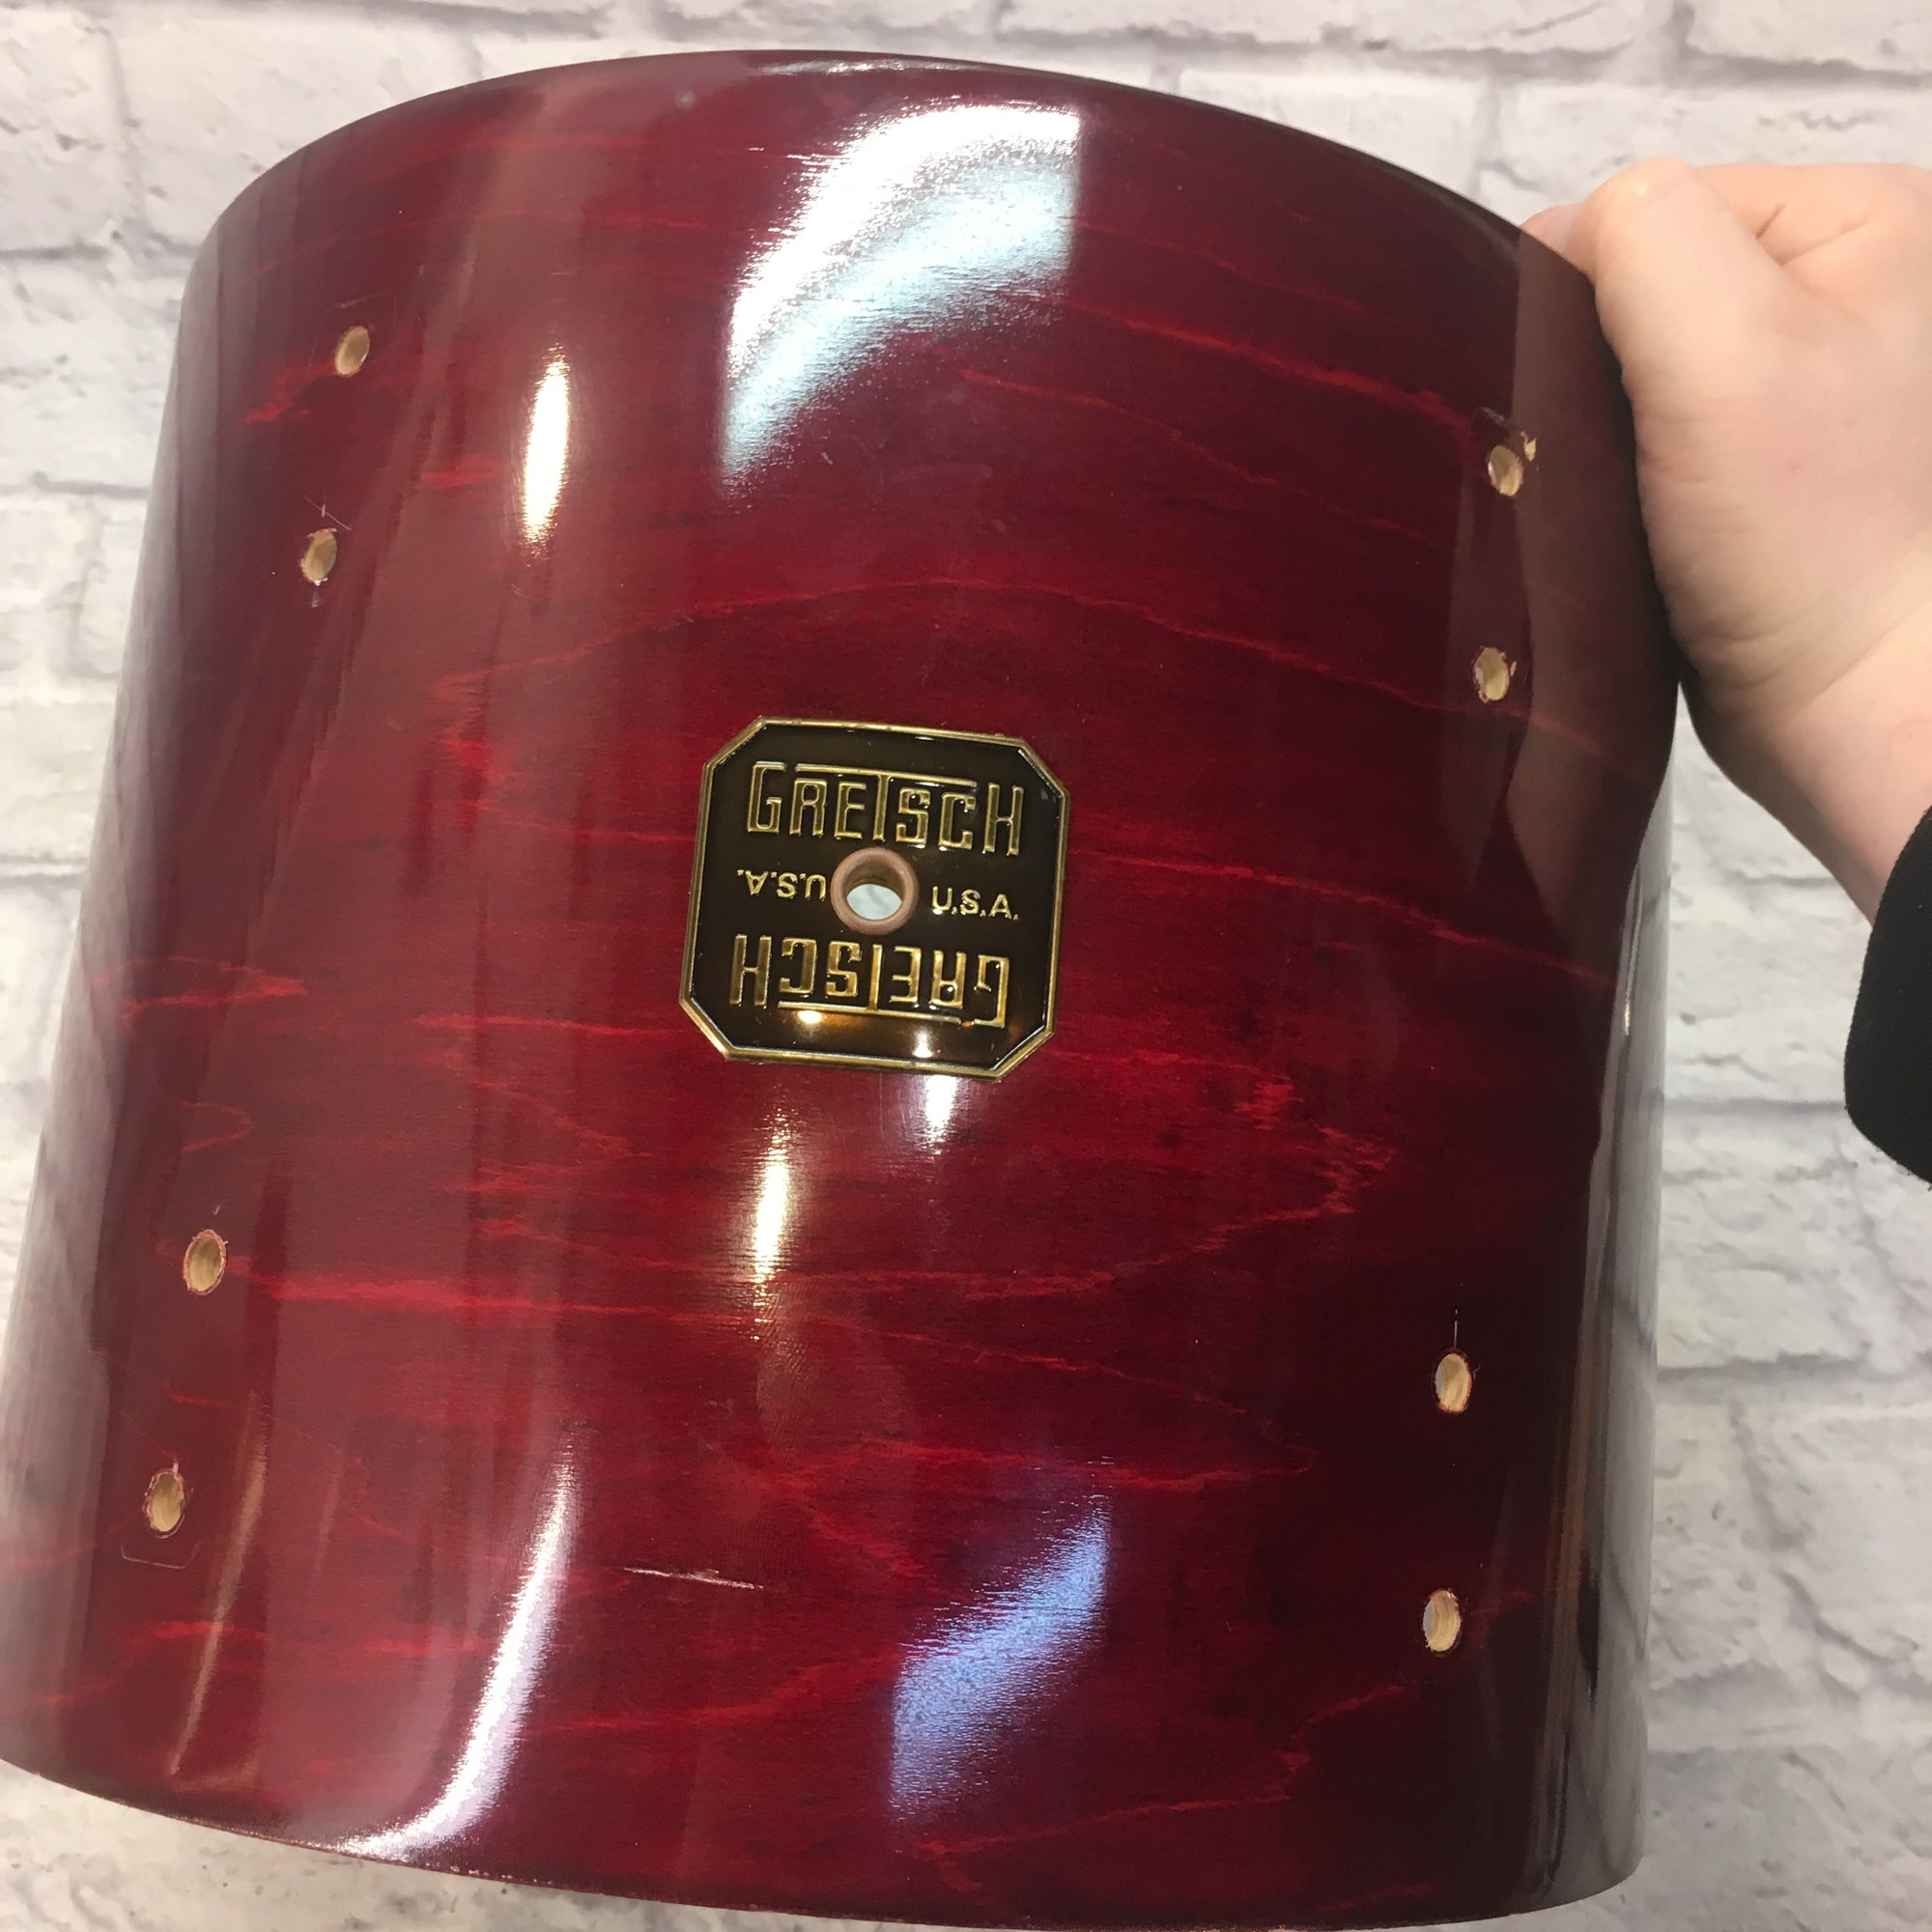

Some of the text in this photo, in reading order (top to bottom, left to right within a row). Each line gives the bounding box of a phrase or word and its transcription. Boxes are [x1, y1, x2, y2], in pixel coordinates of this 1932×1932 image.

[747, 761, 1024, 855] GRETSCH
[737, 869, 827, 901] U.S.A.
[931, 886, 1019, 921] U.S.A.
[729, 934, 1009, 1028] GRETSCH
